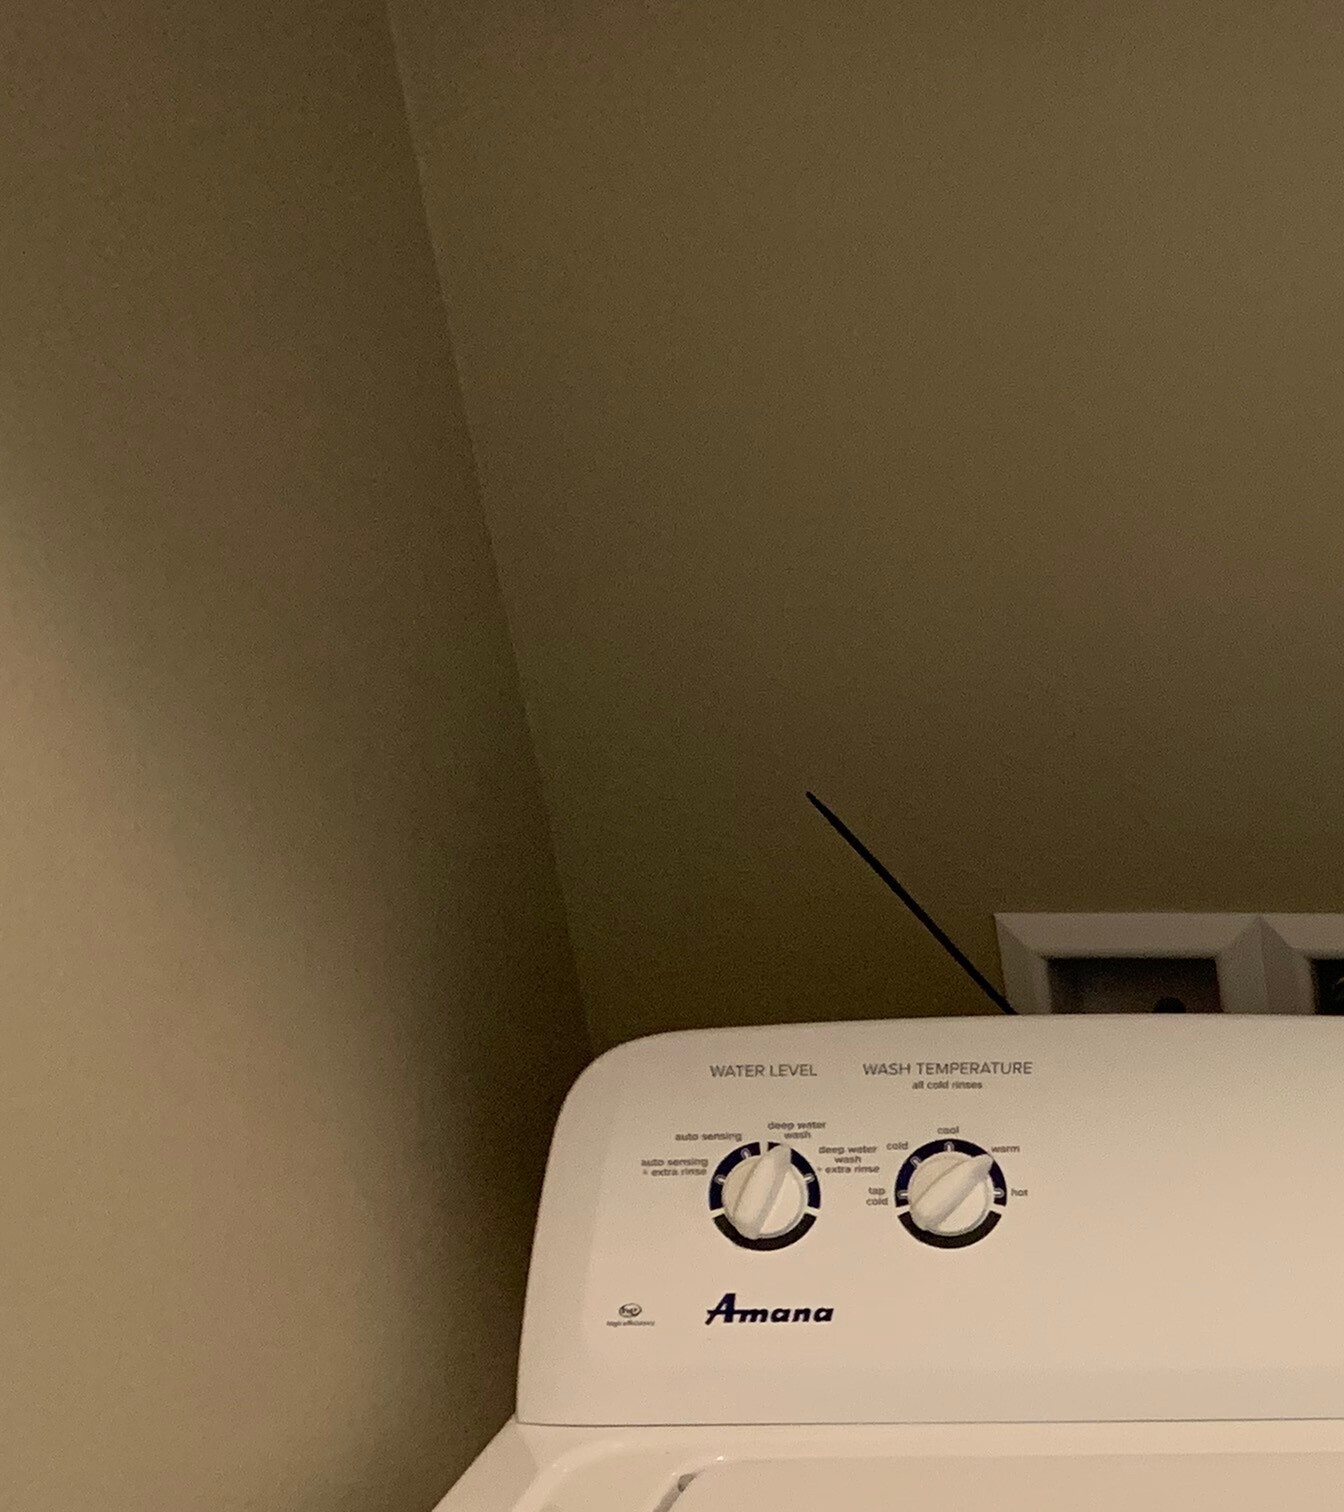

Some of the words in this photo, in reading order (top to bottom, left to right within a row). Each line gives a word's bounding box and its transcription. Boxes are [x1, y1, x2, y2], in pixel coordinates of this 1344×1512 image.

[709, 1064, 765, 1078] WATER
[770, 1063, 818, 1077] LEVEL
[863, 1062, 911, 1076] WASH
[916, 1061, 1033, 1075] TEMPERATURE
[912, 1080, 924, 1090] all
[927, 1080, 949, 1090] cold
[952, 1080, 983, 1090] rinses
[767, 1121, 795, 1131] deep
[797, 1121, 826, 1130] water
[937, 1126, 959, 1135] cool
[675, 1132, 698, 1142] auto
[701, 1132, 742, 1142] sensing
[784, 1131, 811, 1140] wash
[818, 1146, 845, 1155] deep
[847, 1146, 877, 1154] water
[886, 1142, 908, 1151] cold
[991, 1145, 1020, 1153] warm
[641, 1158, 664, 1167] auto
[667, 1158, 709, 1168] sensing
[834, 1156, 861, 1164] wash
[651, 1167, 678, 1177] extra
[681, 1167, 707, 1176] rinse
[825, 1165, 850, 1174] extra
[854, 1165, 880, 1174] rinse
[868, 1187, 885, 1197] tap
[1011, 1188, 1028, 1197] hot
[866, 1198, 889, 1207] cold
[705, 1293, 834, 1326] Amana
